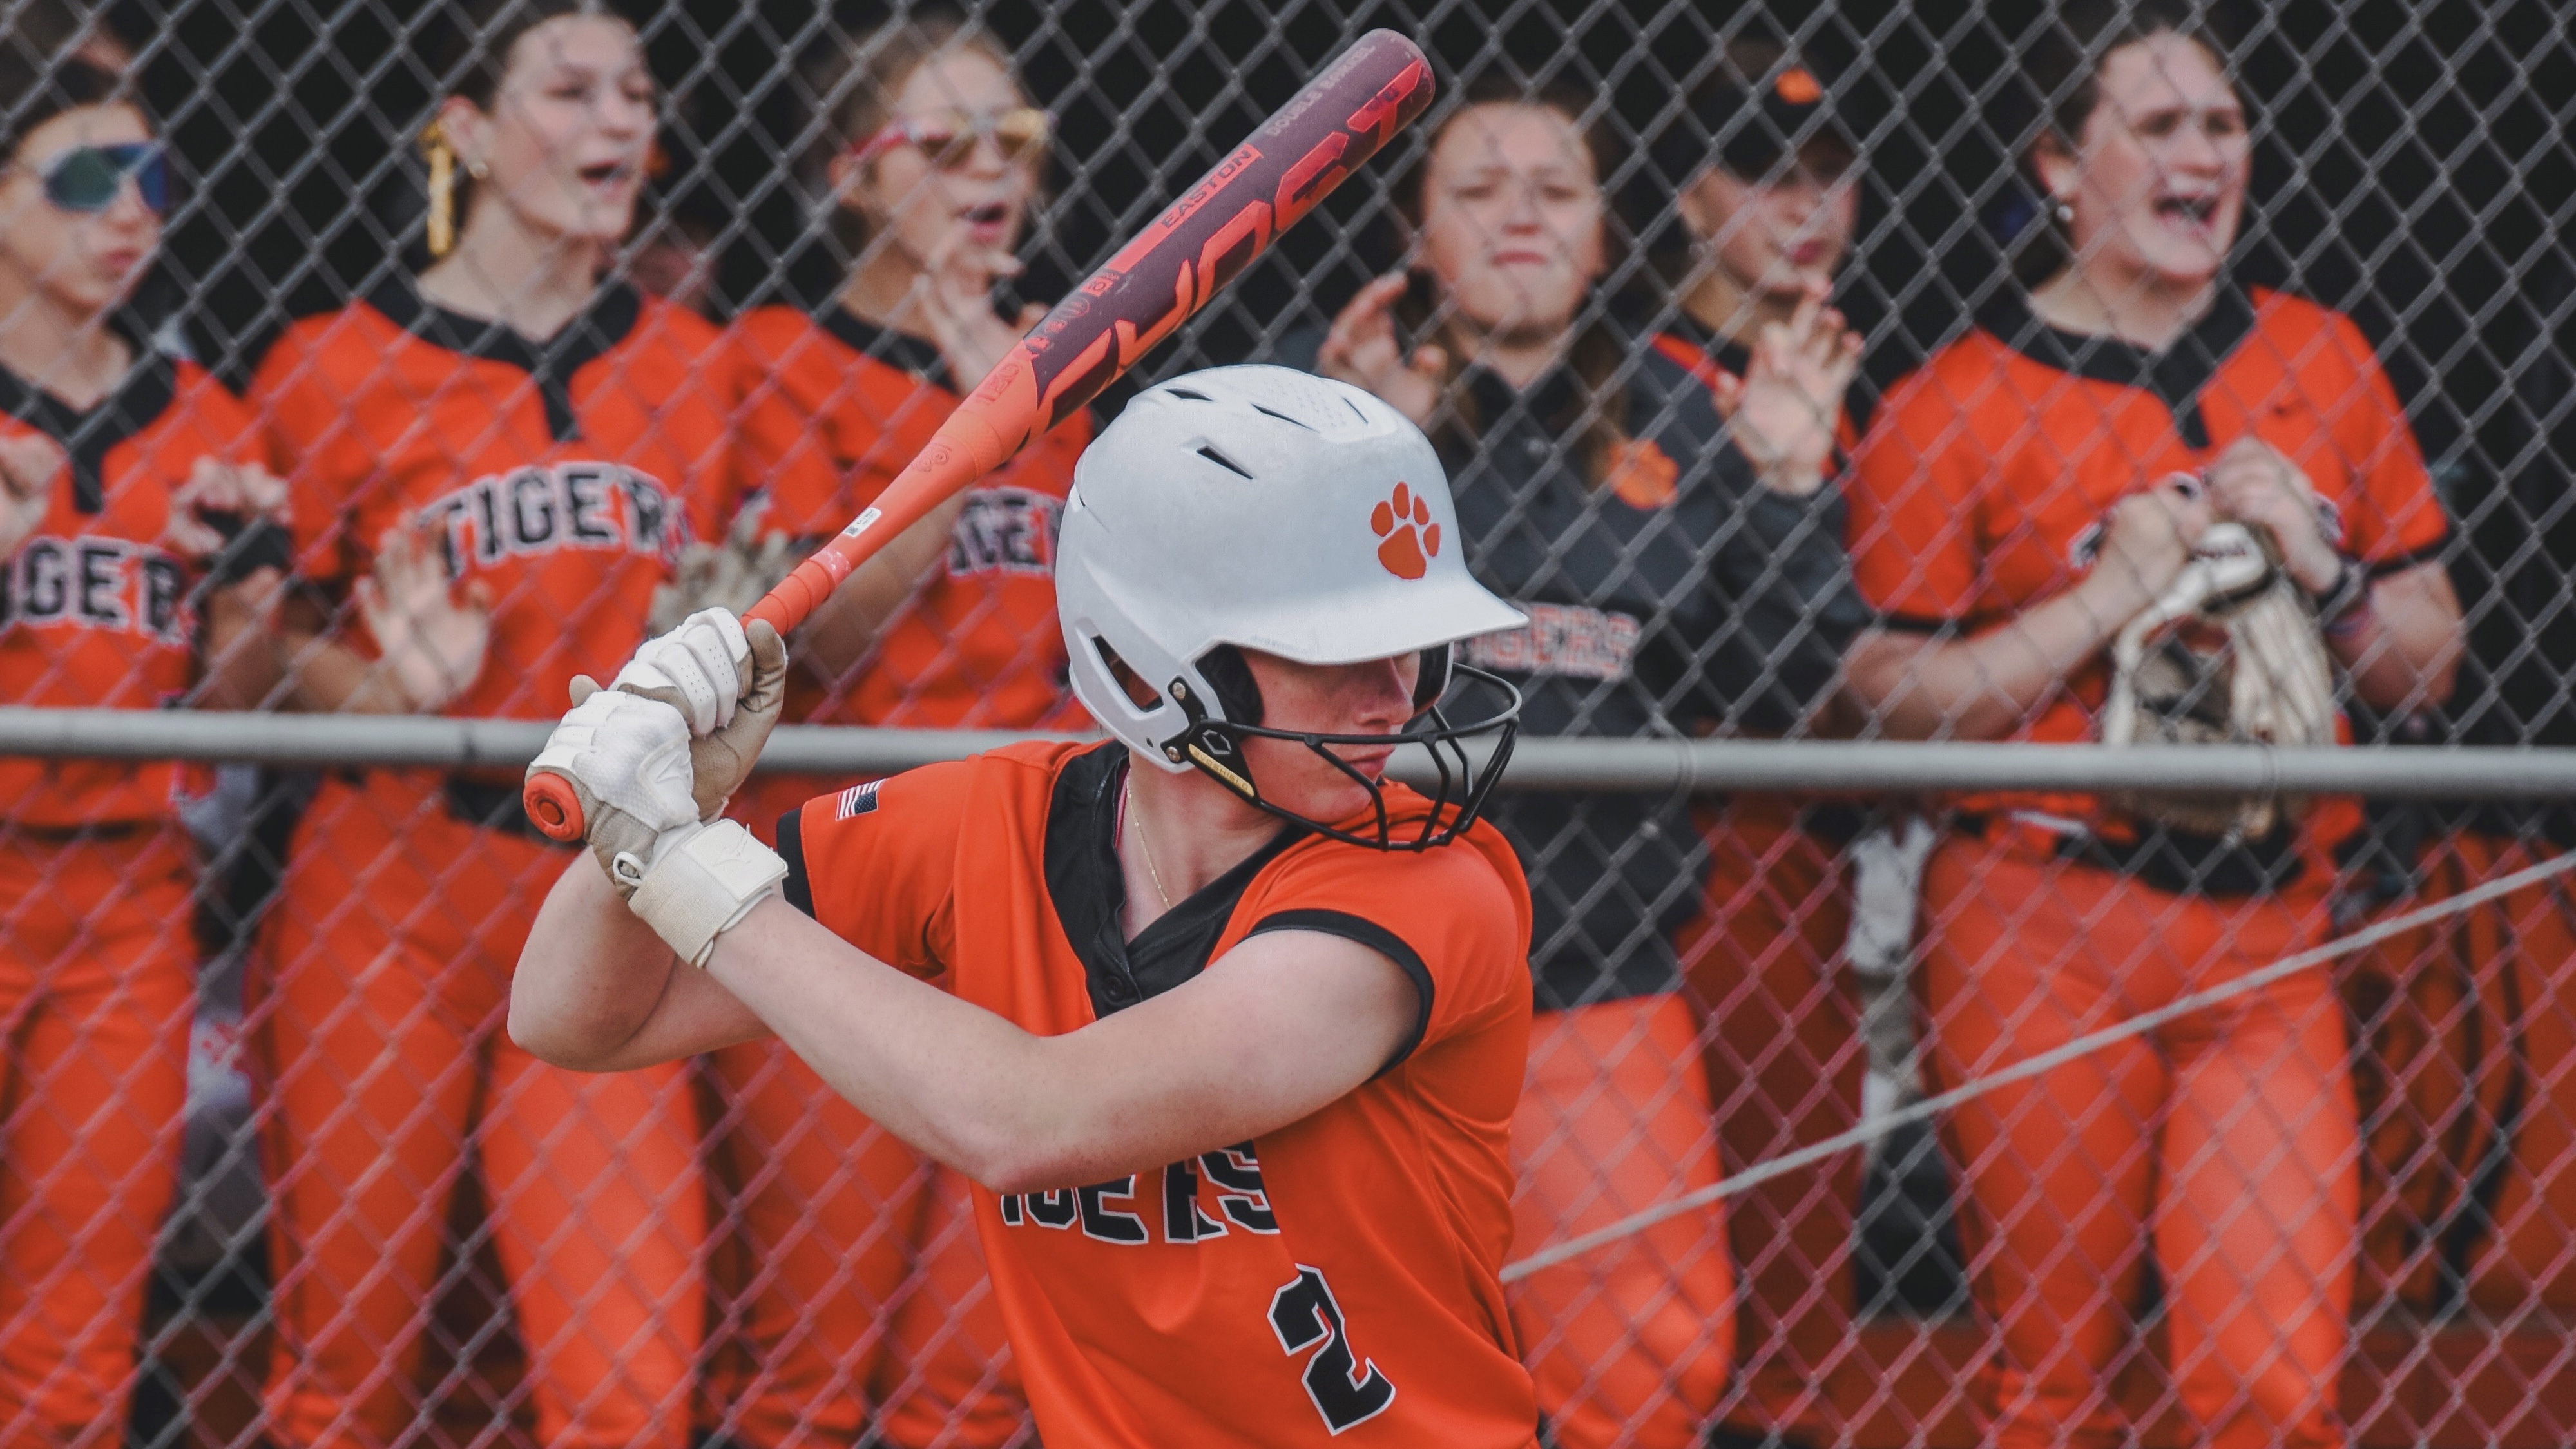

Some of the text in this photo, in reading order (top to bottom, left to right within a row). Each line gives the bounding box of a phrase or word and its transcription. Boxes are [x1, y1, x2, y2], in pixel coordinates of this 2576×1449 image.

[1161, 149, 1251, 229] EASTON
[418, 460, 695, 580] TIGER
[1267, 1262, 1396, 1437] 2
